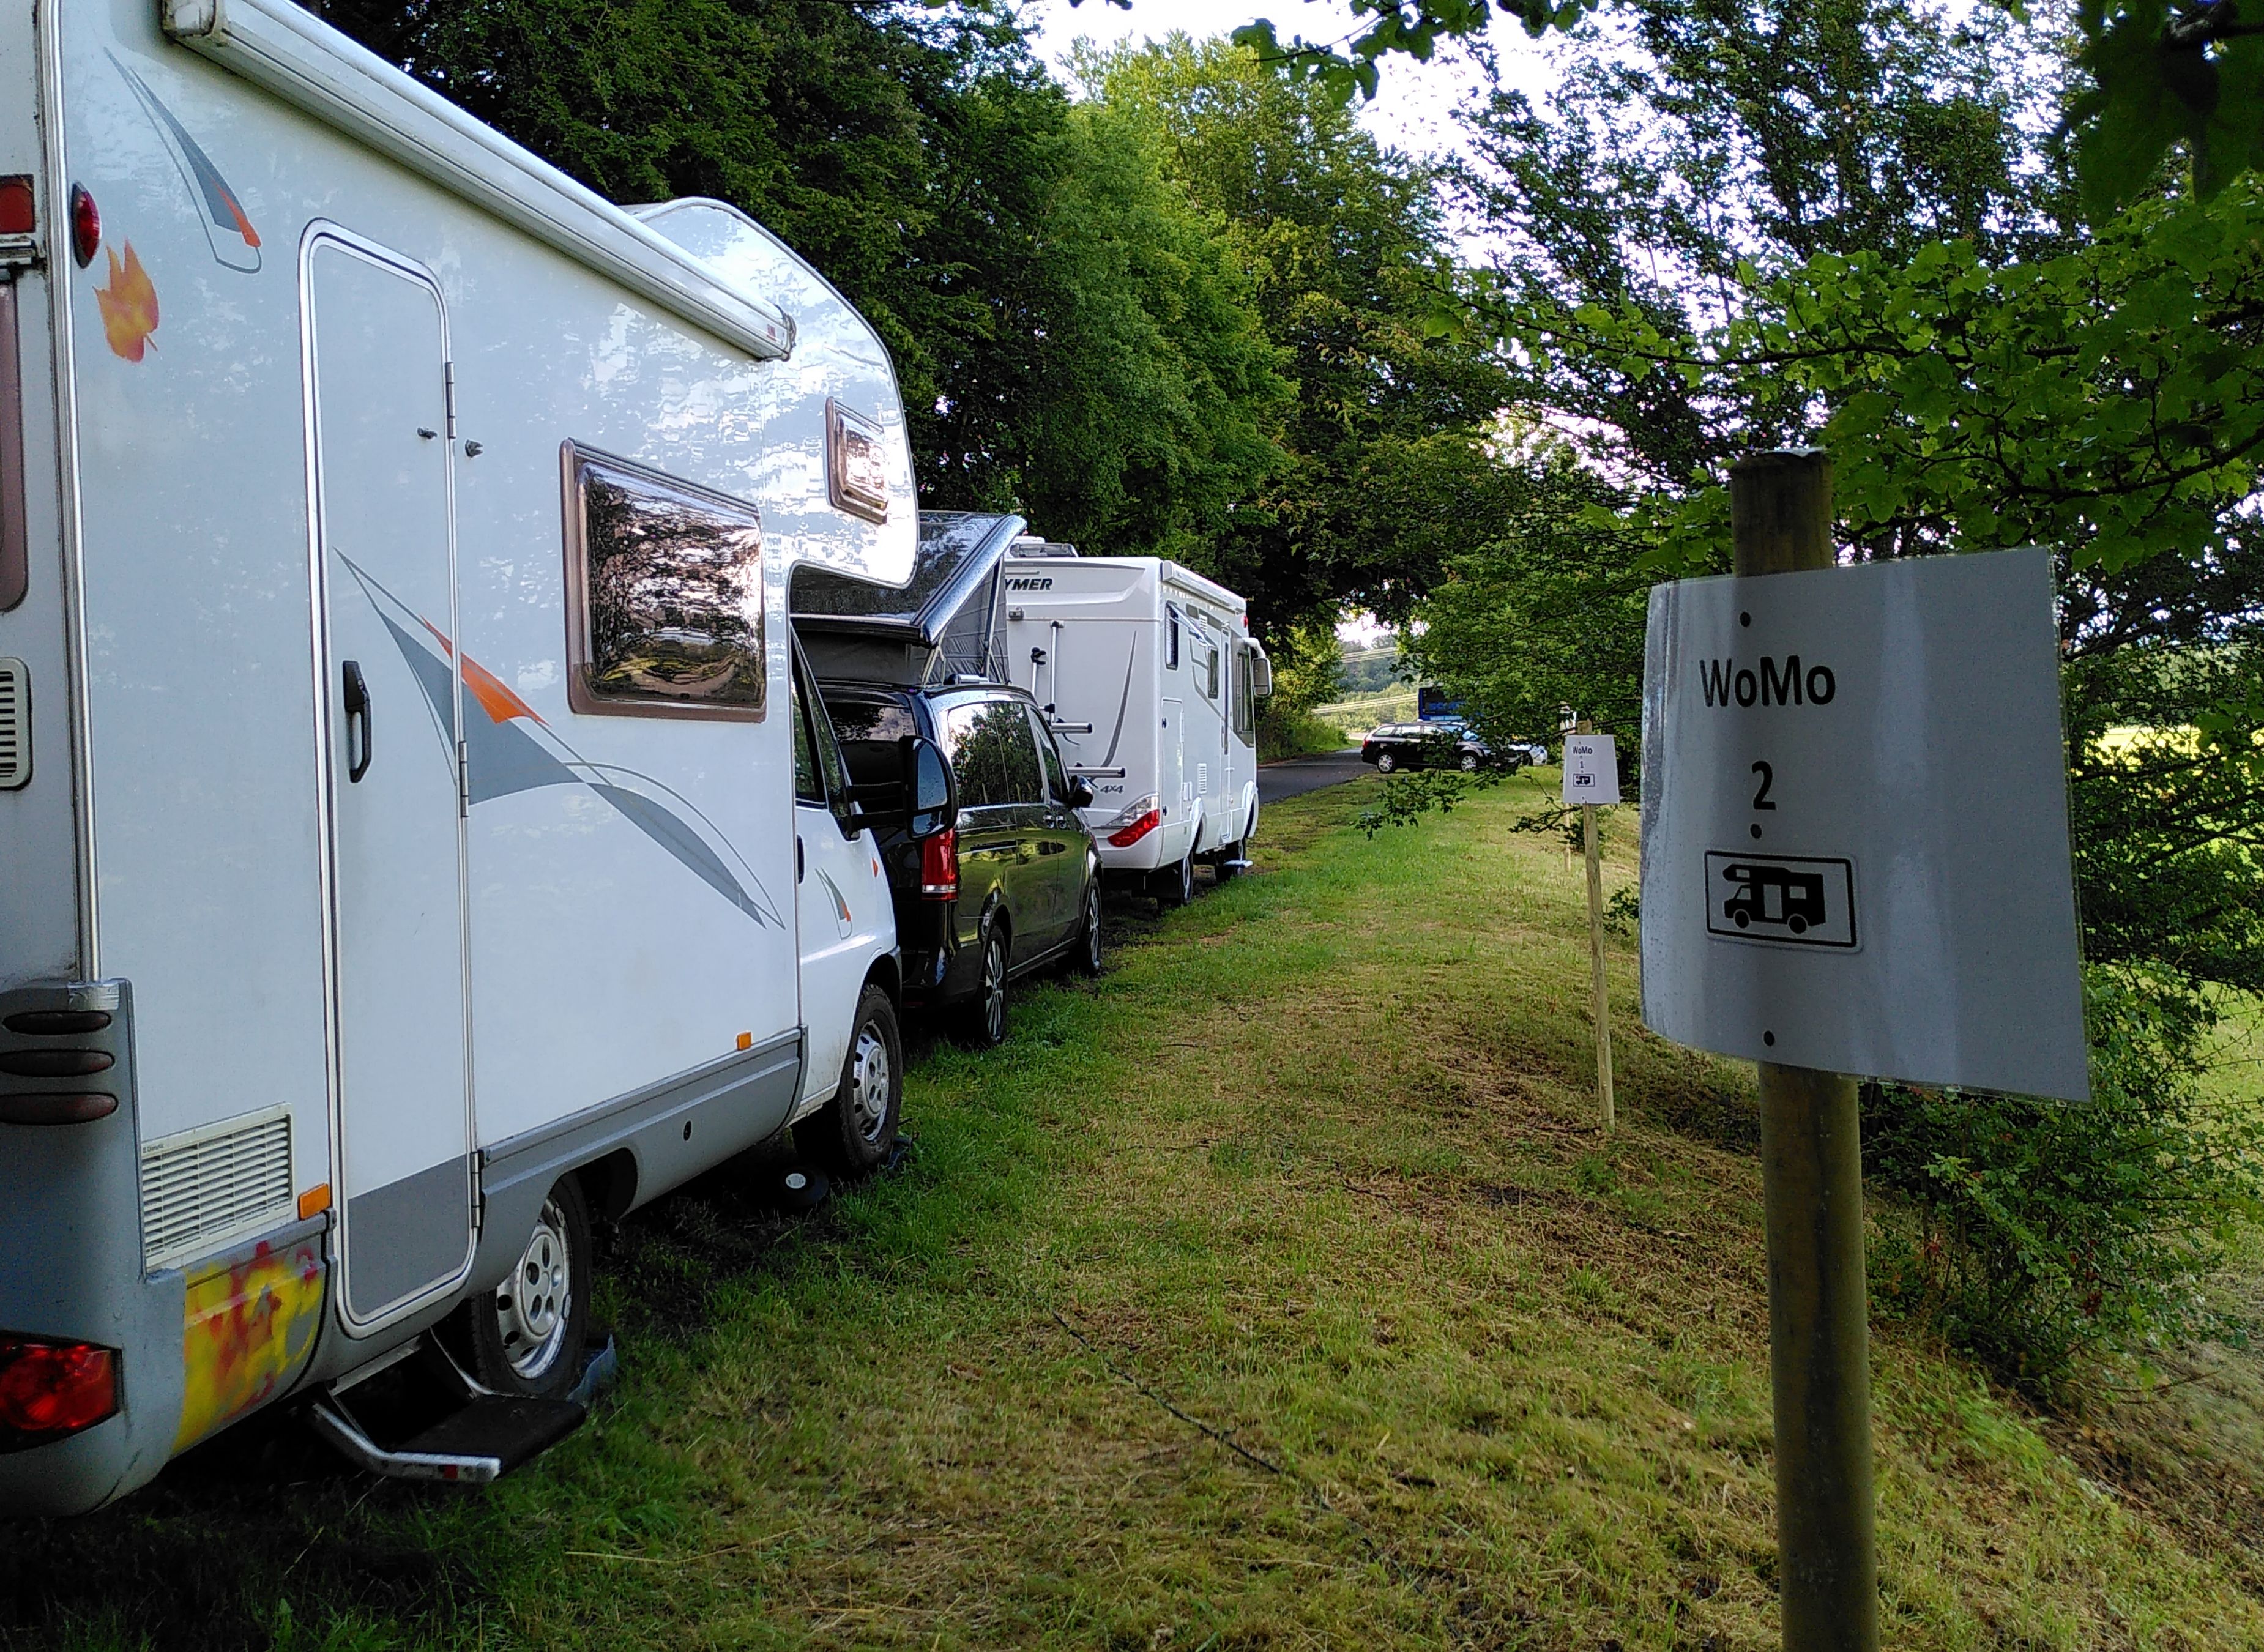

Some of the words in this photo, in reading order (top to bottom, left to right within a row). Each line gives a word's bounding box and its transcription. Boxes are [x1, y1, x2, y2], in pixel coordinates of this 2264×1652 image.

[1005, 578, 1053, 591] YMER
[1699, 655, 1836, 708] WoMo
[1572, 746, 1593, 754] WoMo
[1579, 761, 1584, 769] 1
[1751, 761, 1776, 811] 2
